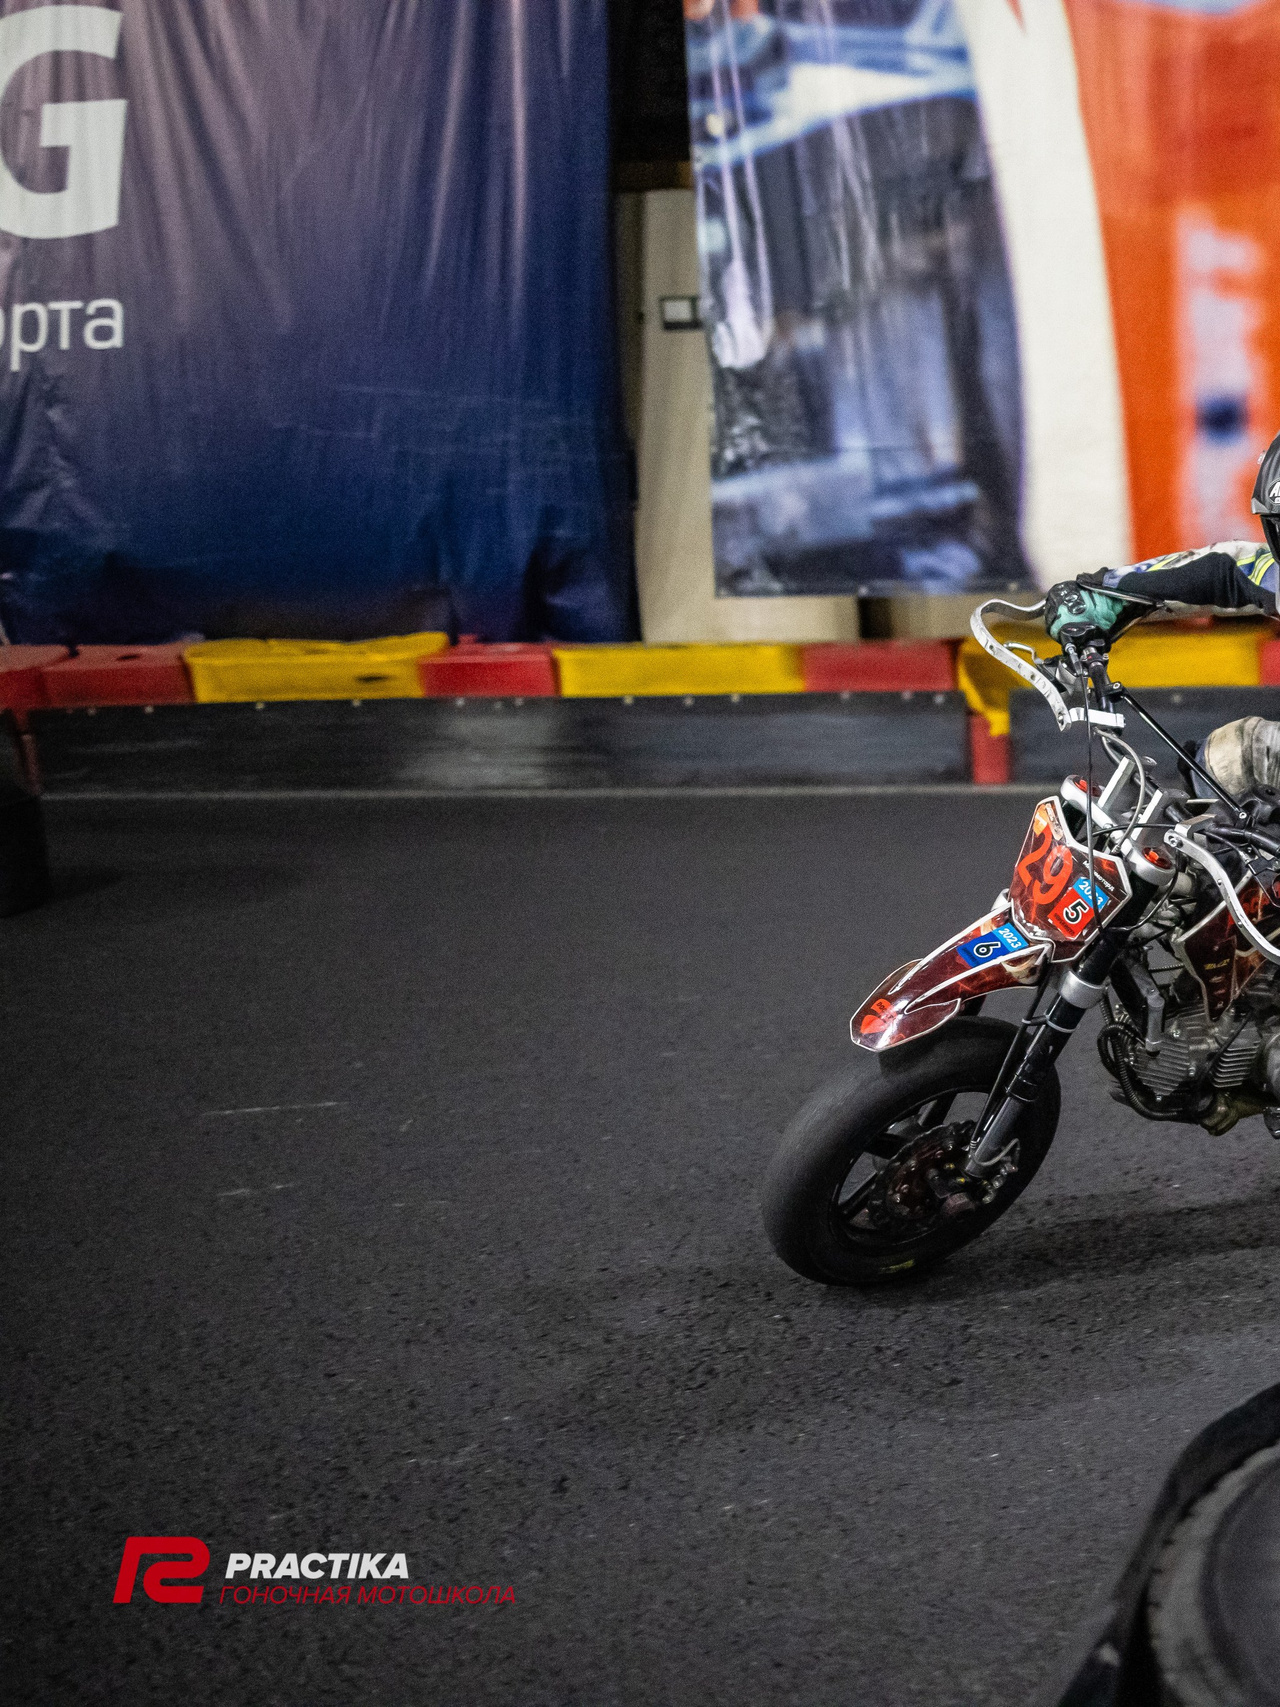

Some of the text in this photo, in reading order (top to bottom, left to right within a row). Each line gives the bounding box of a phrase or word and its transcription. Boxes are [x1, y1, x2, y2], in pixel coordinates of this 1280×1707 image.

[0, 298, 124, 372] рта
[1017, 823, 1073, 905] 29
[1078, 880, 1104, 906] 203
[1063, 898, 1089, 924] 5
[973, 941, 1001, 958] 6
[998, 927, 1022, 949] 2023
